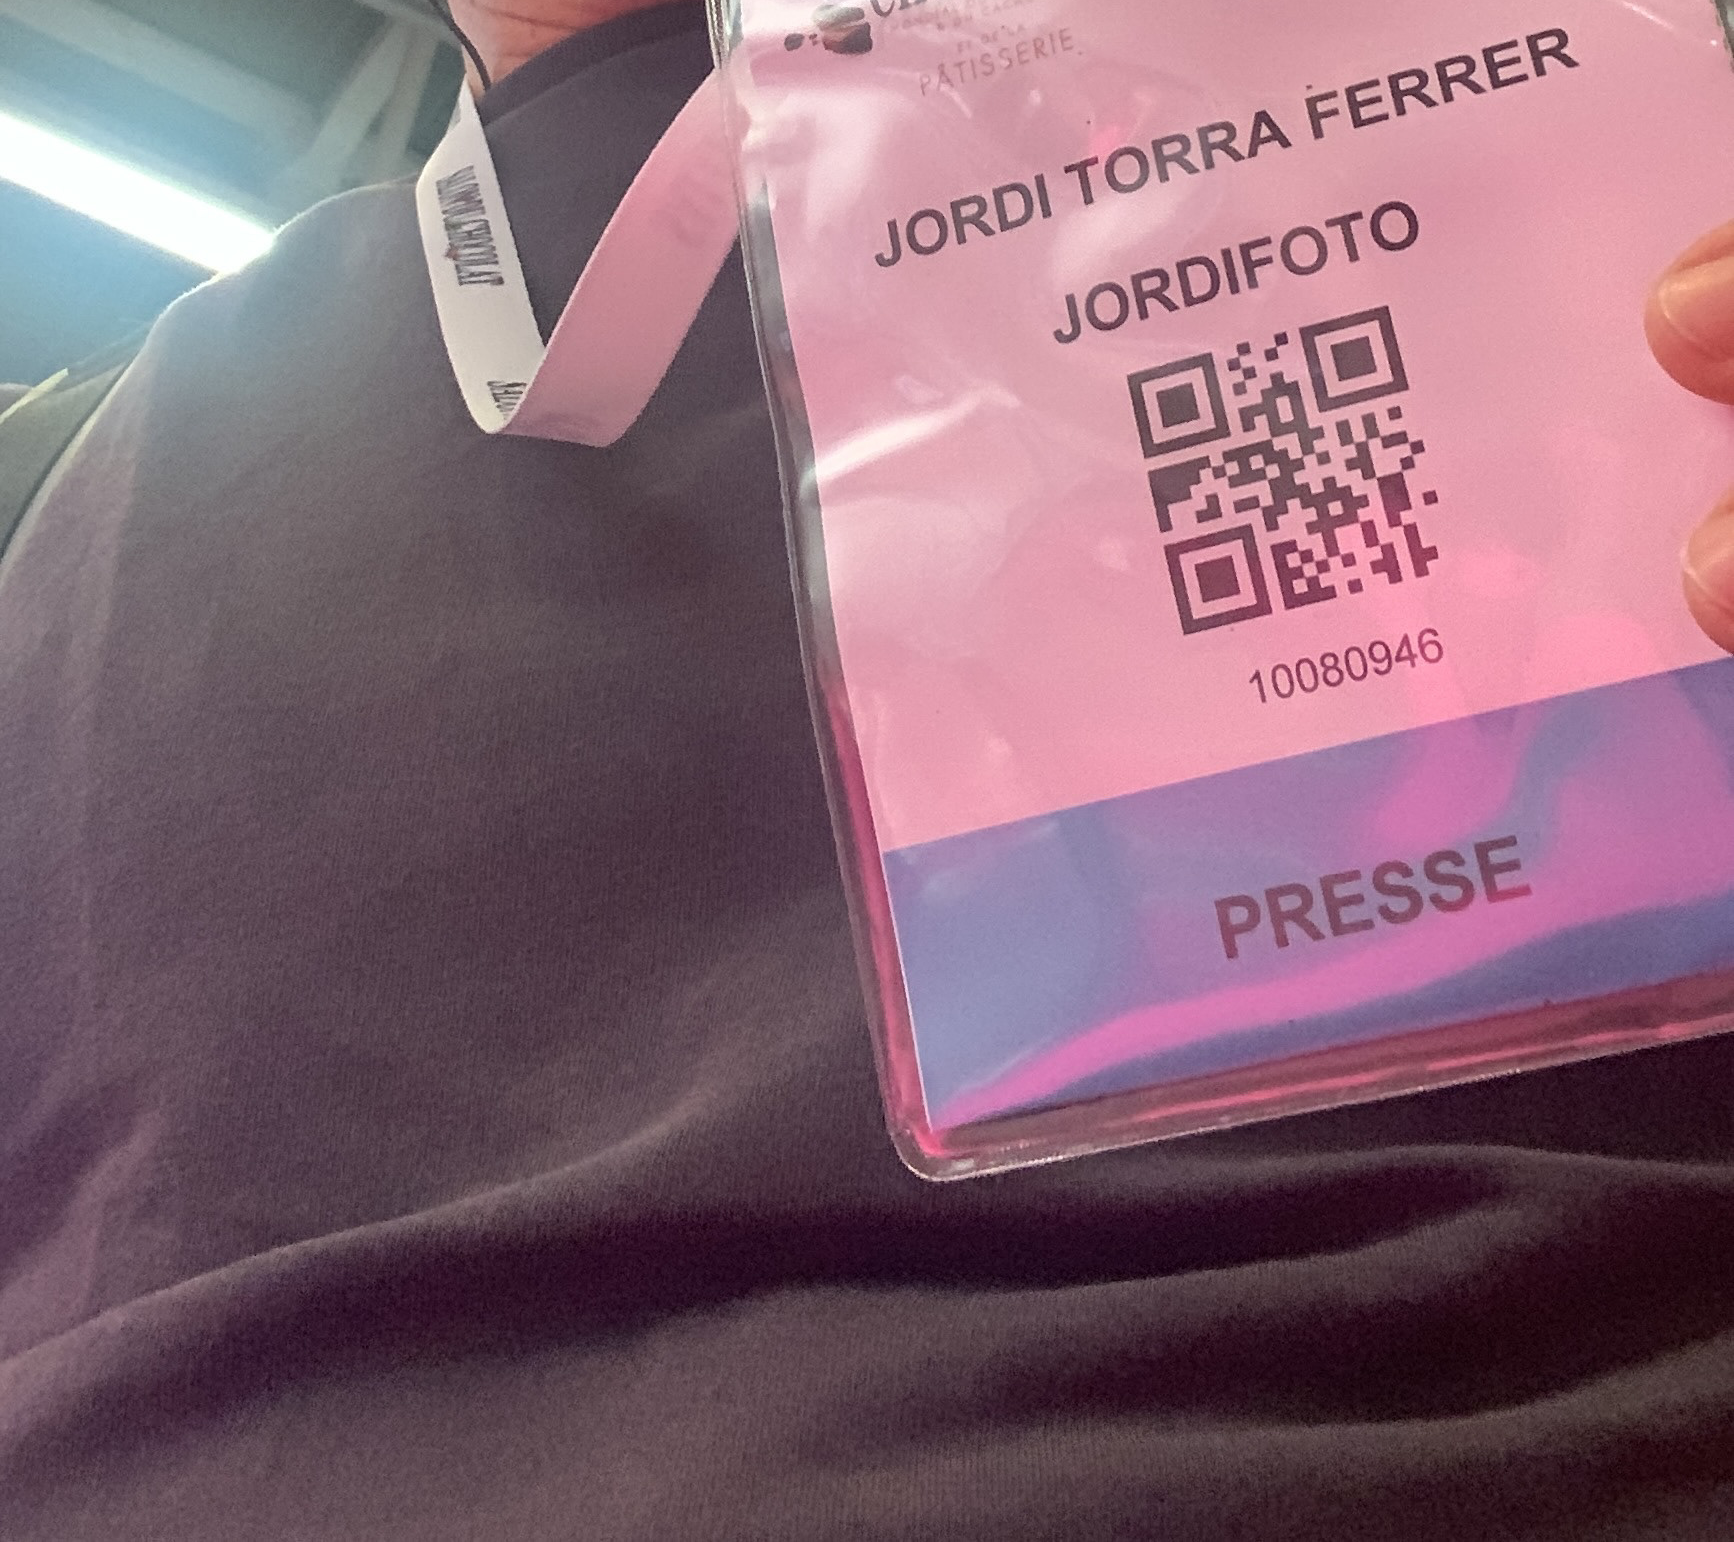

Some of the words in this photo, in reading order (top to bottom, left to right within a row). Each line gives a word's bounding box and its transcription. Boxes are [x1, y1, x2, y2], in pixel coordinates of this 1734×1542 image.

[874, 172, 1052, 268] JORDI
[1064, 109, 1292, 205] TORRA
[1305, 27, 1580, 140] FERRER
[1052, 200, 1420, 344] JORDIFOTO
[1248, 627, 1445, 704] 10080946
[1213, 834, 1534, 960] PRESSE
